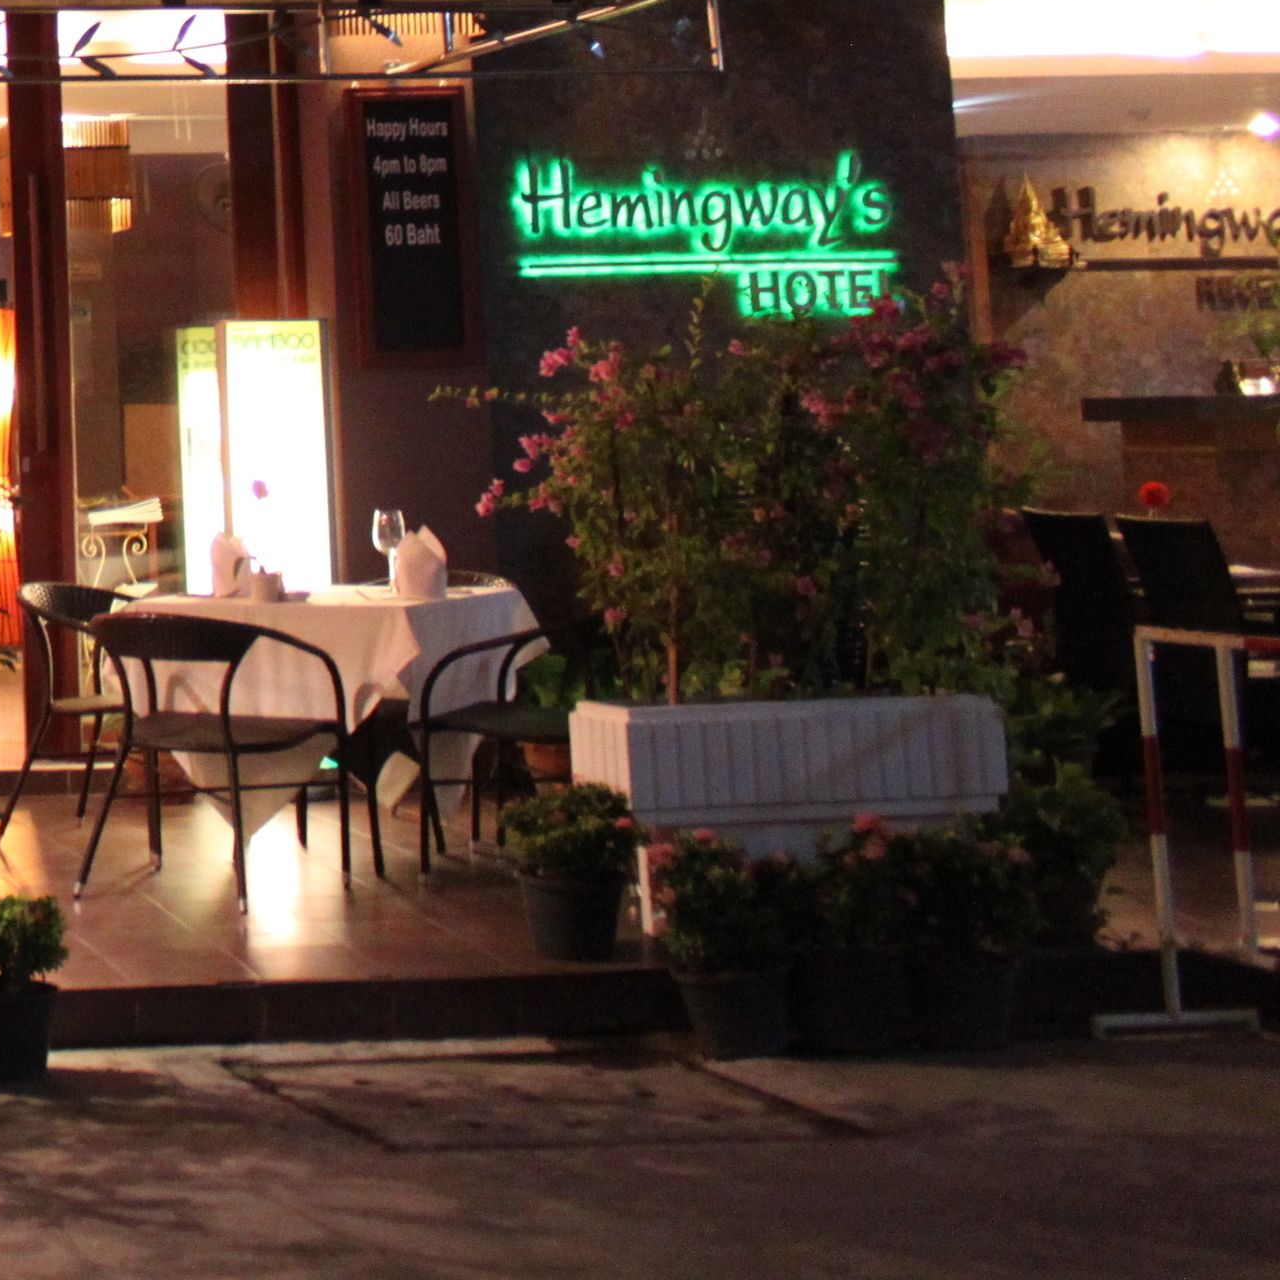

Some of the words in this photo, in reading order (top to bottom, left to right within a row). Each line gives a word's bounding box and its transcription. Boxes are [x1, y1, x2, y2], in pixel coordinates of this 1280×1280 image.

[366, 118, 407, 141] Happy
[409, 118, 448, 137] Hours
[373, 155, 401, 178] 4pm
[403, 155, 417, 173] to
[419, 153, 447, 177] 8pm
[382, 191, 400, 210] All
[403, 190, 441, 210] Beers
[522, 151, 891, 252] Hemingway's
[385, 223, 403, 246] 60
[406, 222, 441, 246] Baht
